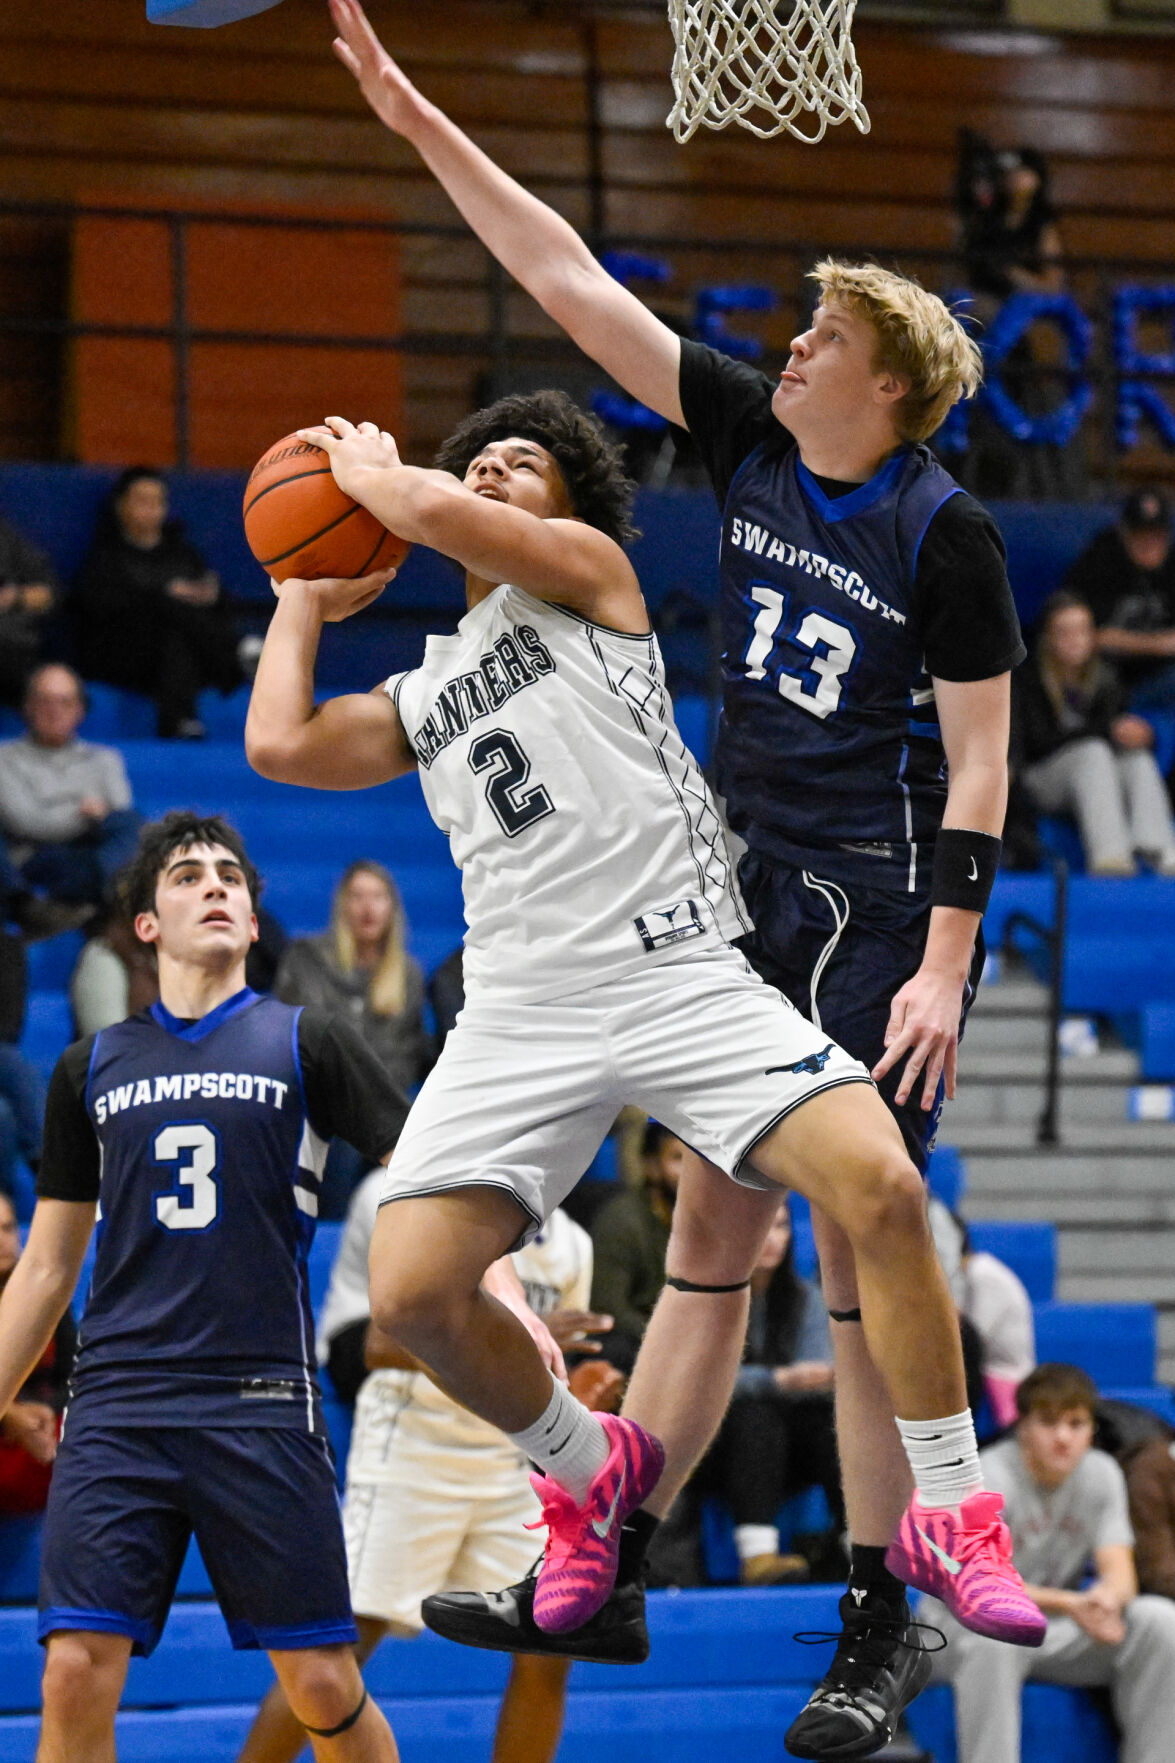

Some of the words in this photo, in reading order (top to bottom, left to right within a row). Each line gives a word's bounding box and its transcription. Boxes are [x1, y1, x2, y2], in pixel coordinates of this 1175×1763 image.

[743, 584, 858, 720] 13
[466, 727, 557, 839] 2
[94, 1072, 288, 1125] SWAMPSCOTT
[154, 1123, 218, 1231] 3
